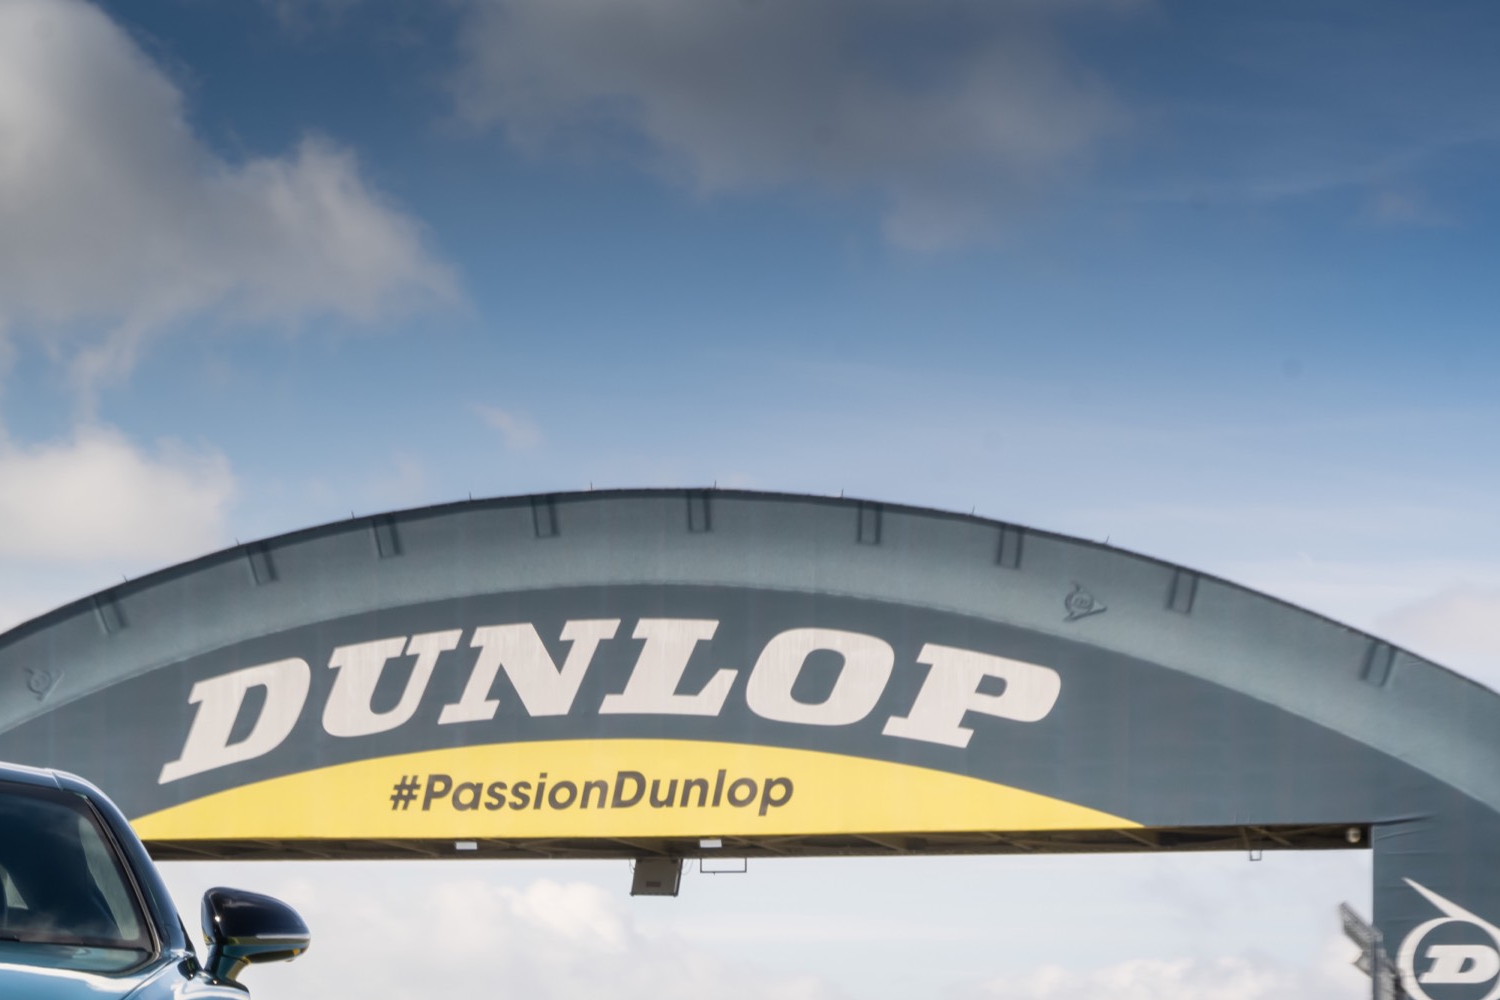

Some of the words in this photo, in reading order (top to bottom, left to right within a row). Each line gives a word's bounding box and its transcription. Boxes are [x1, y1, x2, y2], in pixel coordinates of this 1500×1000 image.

[157, 618, 1062, 785] DUNLOP
[390, 769, 794, 816] #PassionDunlop
[1419, 944, 1500, 984] D
